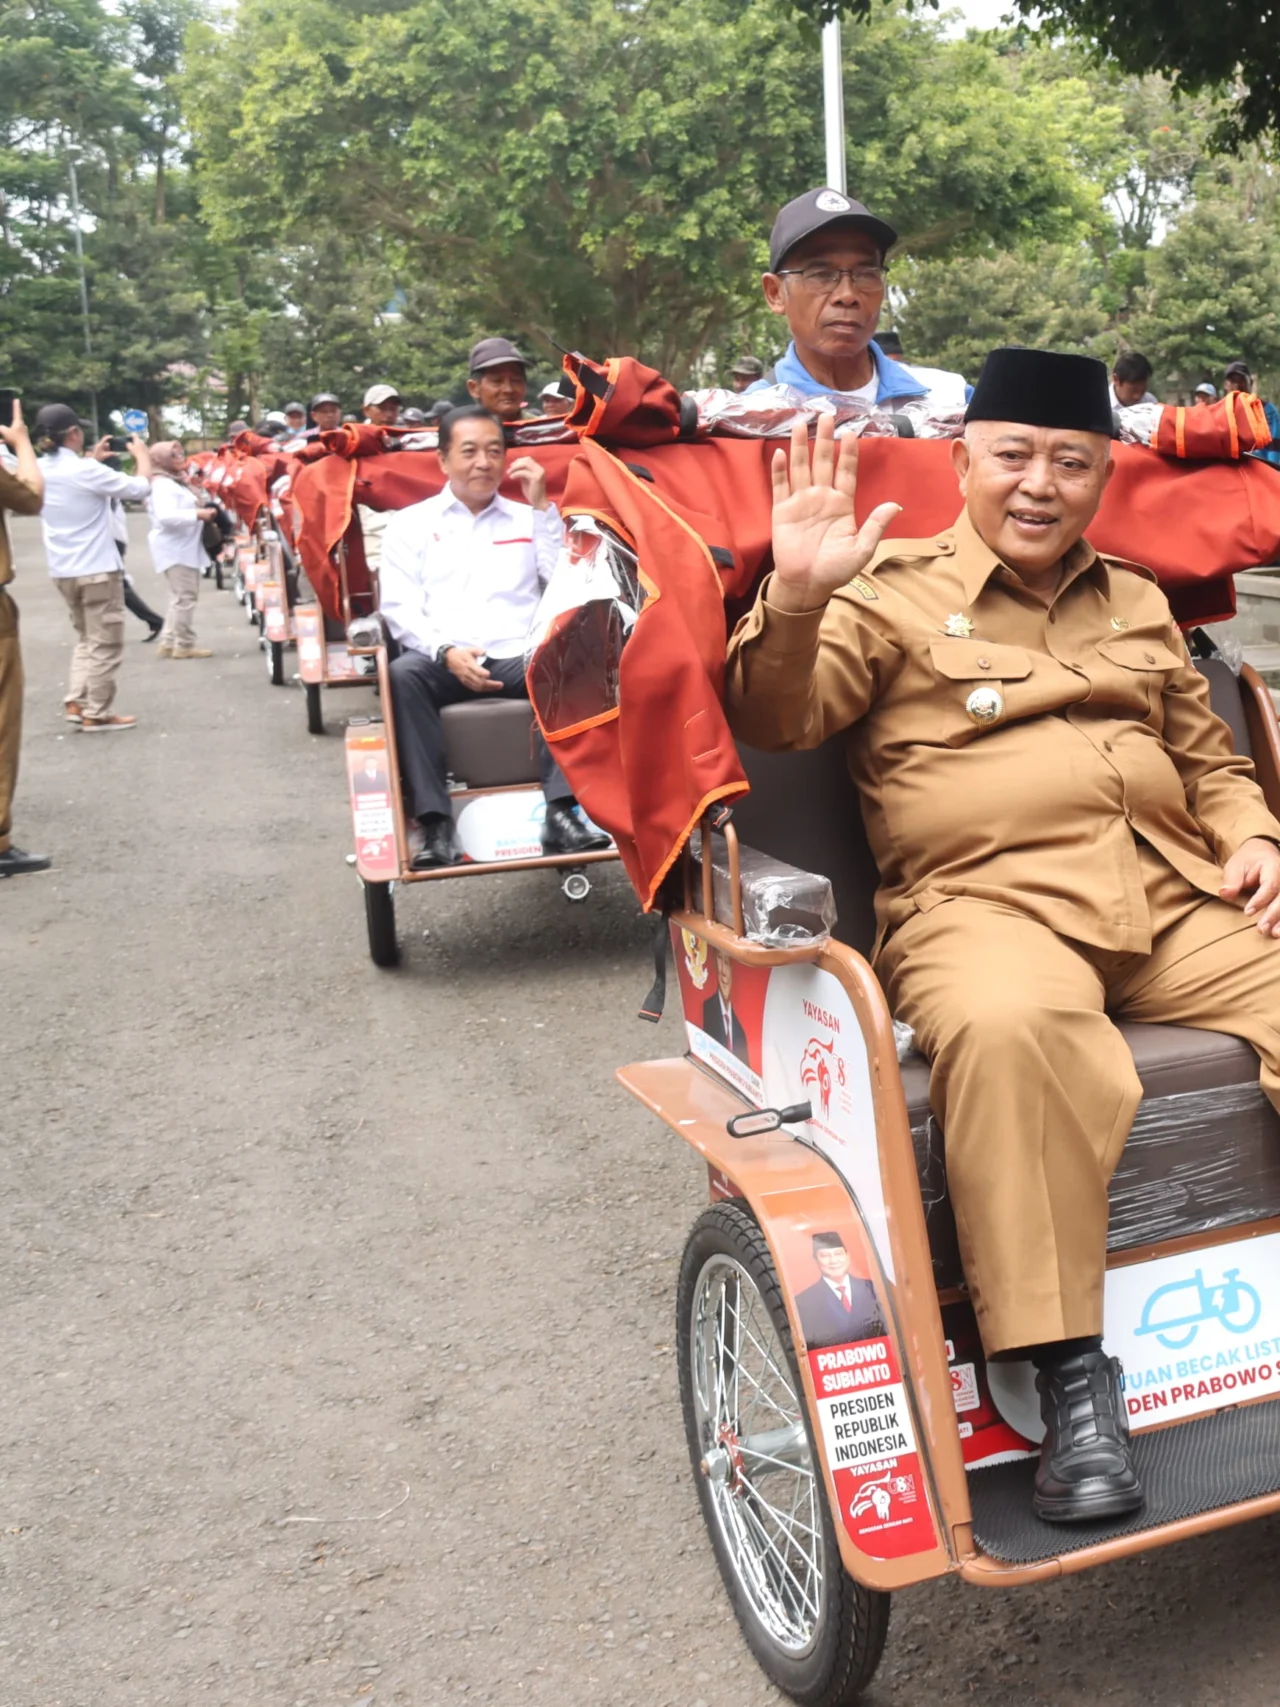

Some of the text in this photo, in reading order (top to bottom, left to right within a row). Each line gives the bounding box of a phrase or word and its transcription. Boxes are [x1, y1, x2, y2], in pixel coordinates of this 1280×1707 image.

[803, 999, 840, 1034] YAYASAN
[816, 1342, 887, 1371] PRABOWO
[1177, 1347, 1241, 1378] BECAK
[822, 1363, 891, 1392] SUBIANTO
[1127, 1391, 1174, 1416] DEN
[1171, 1366, 1273, 1404] PRABOWO
[830, 1392, 895, 1419] PRESIDEN
[834, 1412, 899, 1440] REPUBLIK
[835, 1432, 908, 1462] INDONESIA
[849, 1458, 898, 1477] YAYASAN
